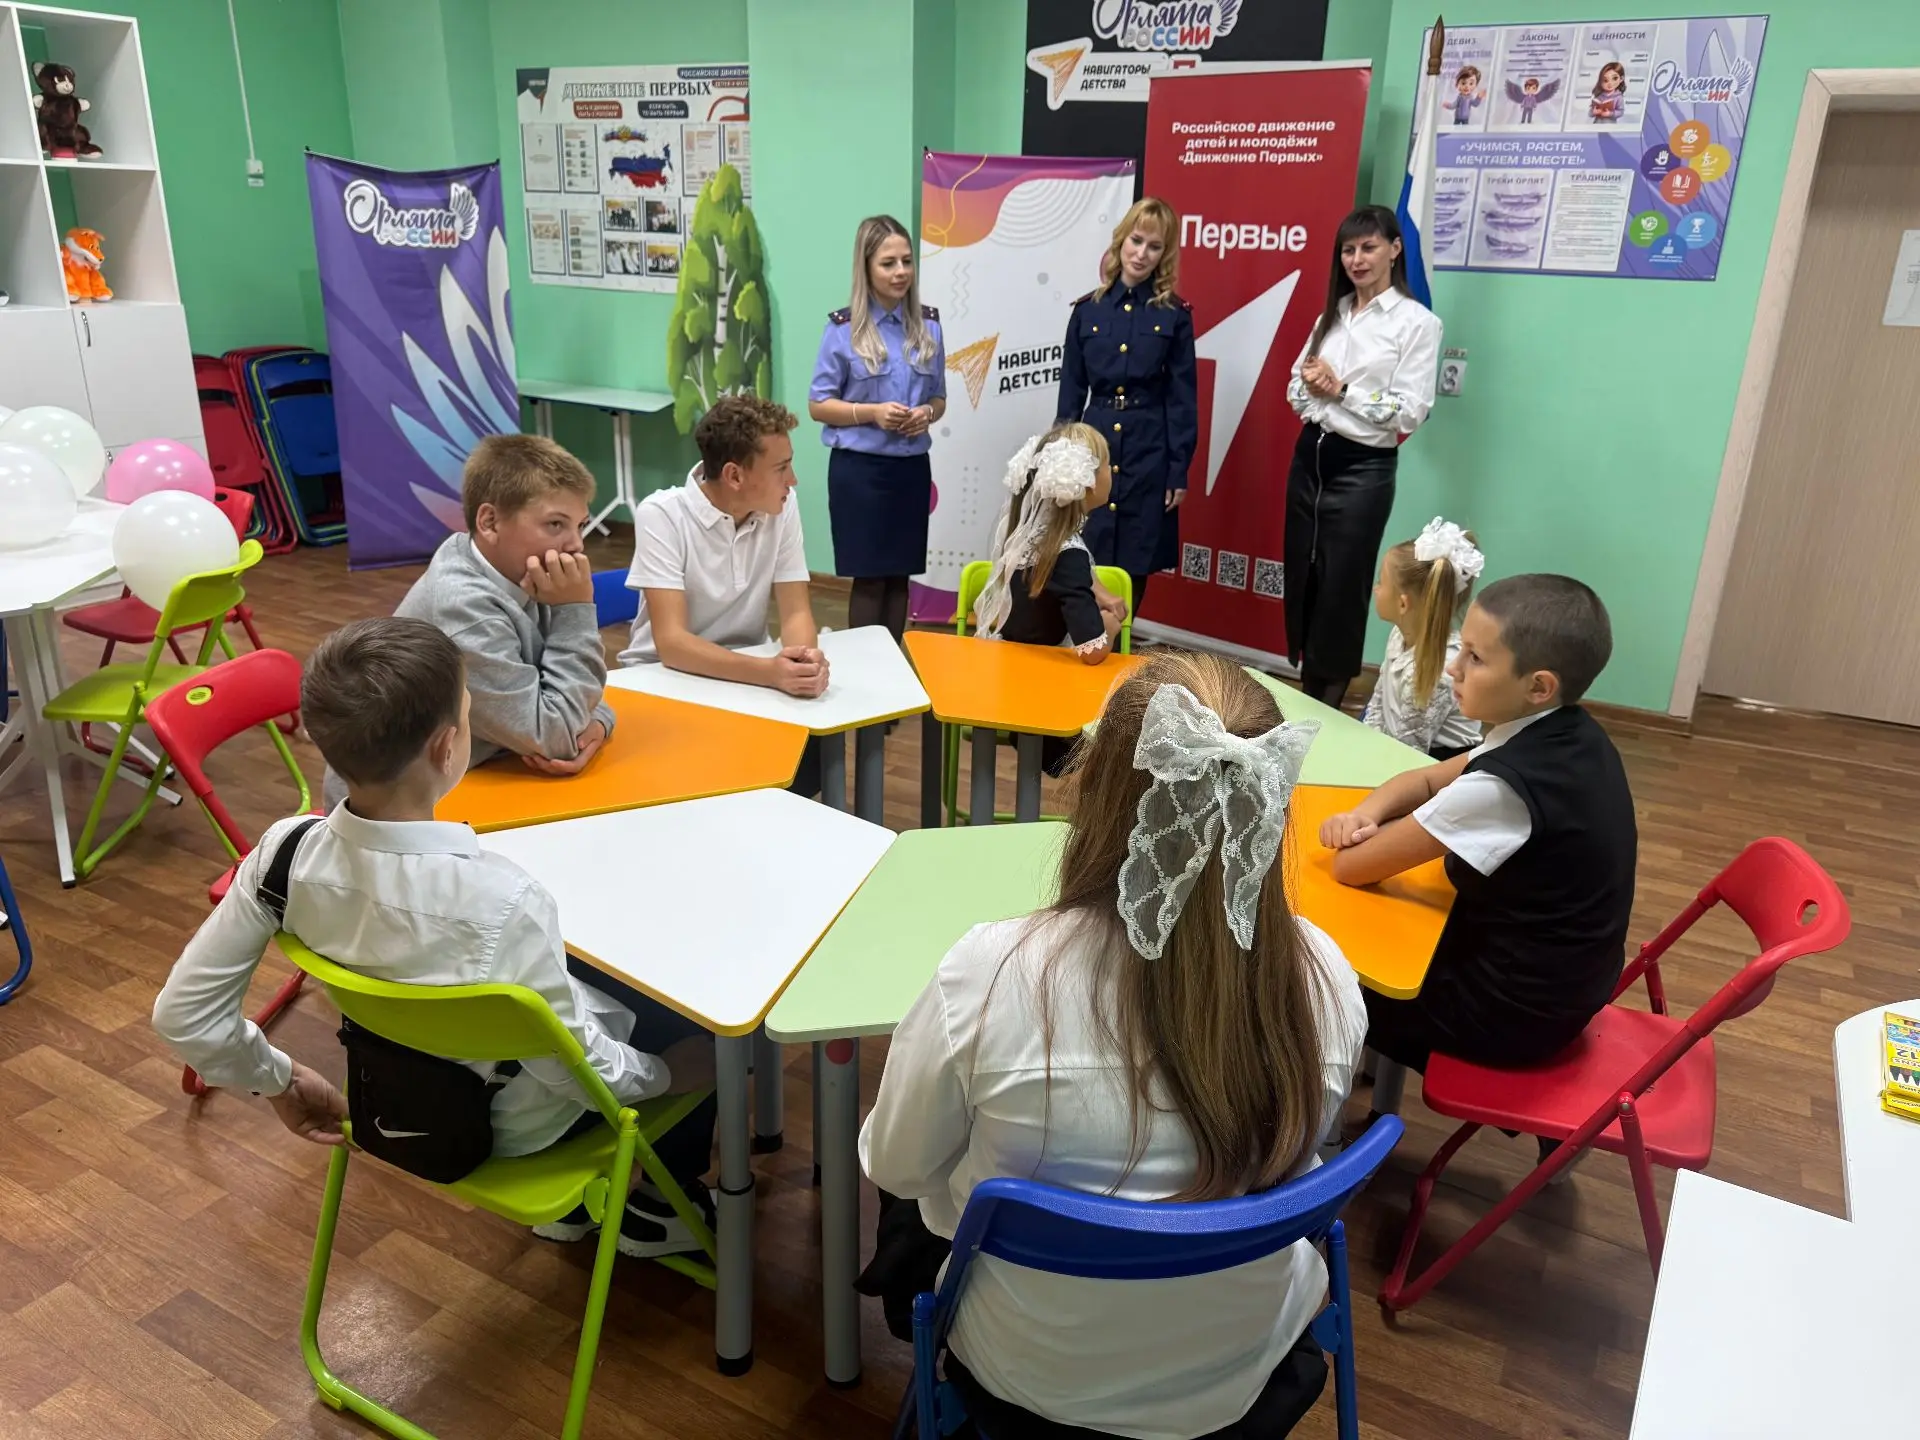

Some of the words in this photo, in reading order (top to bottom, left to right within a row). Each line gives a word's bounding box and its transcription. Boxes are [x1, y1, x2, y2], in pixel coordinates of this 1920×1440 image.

[1097, 0, 1213, 39] Орлята
[1123, 26, 1211, 48] РОССИИ
[1520, 33, 1559, 41] ЗАКОНЫ
[1592, 32, 1646, 40] ЦЕННОСТИ
[1083, 64, 1151, 75] НАВИГАТОРЫ
[1080, 79, 1126, 90] ДЕТСТВА
[1654, 60, 1734, 96] Орлята
[562, 83, 646, 101] ДВИЖЕНИЕ
[650, 81, 712, 97] ПЕРВЫХ
[1172, 121, 1255, 134] Российское
[1258, 120, 1336, 133] движение
[1185, 135, 1227, 149] детей
[1228, 139, 1238, 148] и
[1240, 135, 1318, 149] молодёжи
[1460, 142, 1522, 153] «УЧИМСЯ,
[1526, 142, 1585, 153] РАСТЕМ,
[1178, 151, 1256, 165] «Движение
[1259, 150, 1323, 165] Первых»
[1456, 156, 1519, 165] МЕЧТАЕМ
[1522, 156, 1586, 166] ВМЕСТЕ!»
[1570, 174, 1622, 183] ТРАДИЦИИ
[350, 182, 457, 235] Орлята
[1180, 214, 1308, 260] Первые
[998, 345, 1065, 371] НАВИГА
